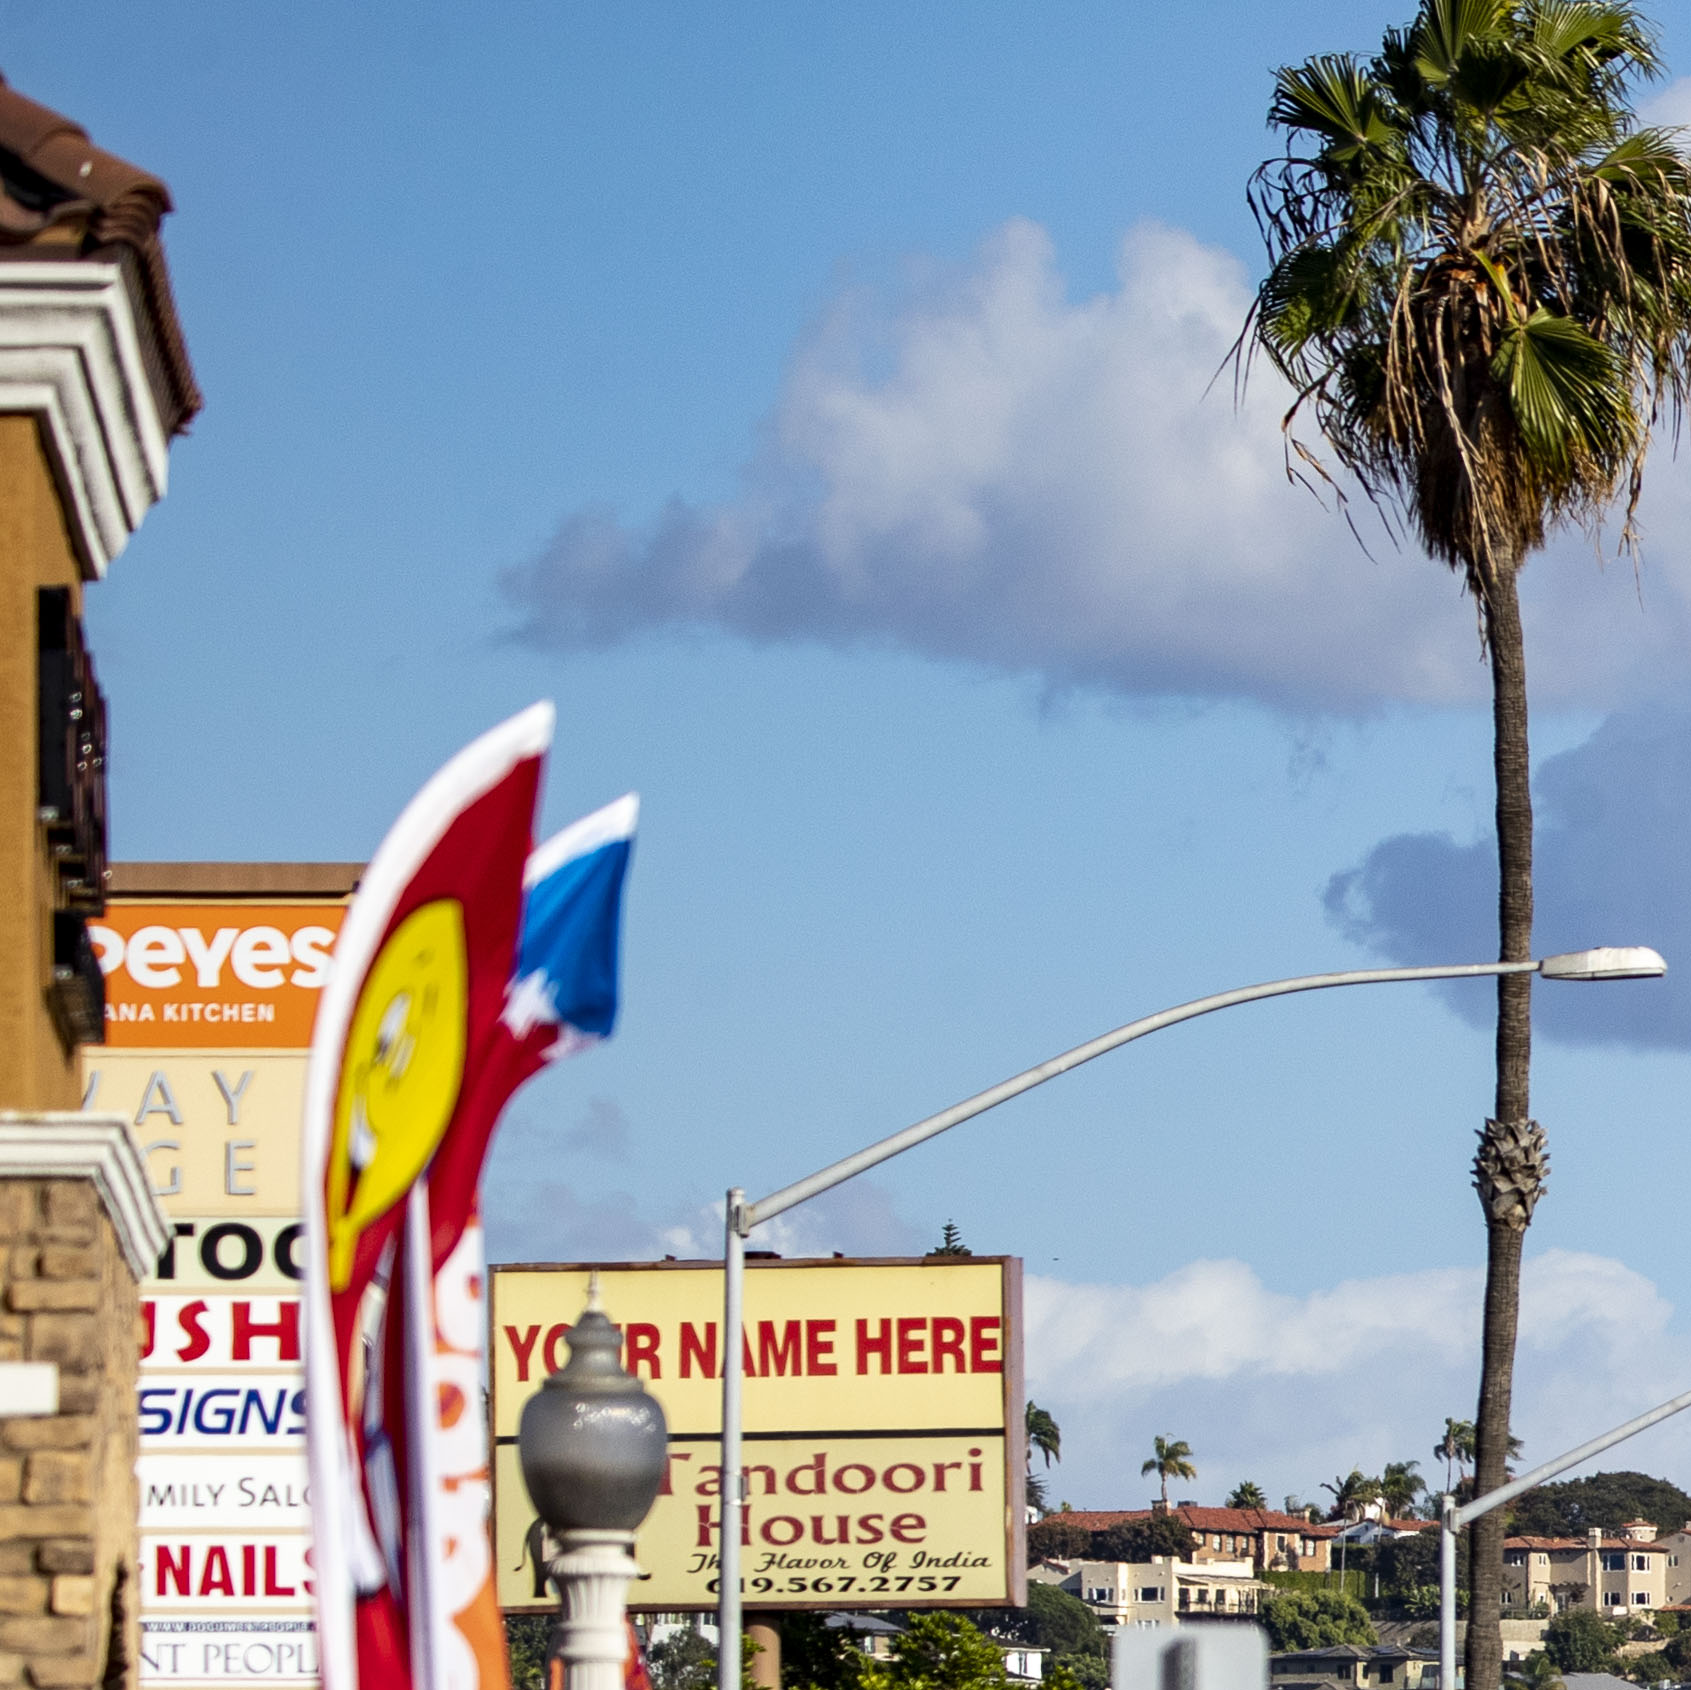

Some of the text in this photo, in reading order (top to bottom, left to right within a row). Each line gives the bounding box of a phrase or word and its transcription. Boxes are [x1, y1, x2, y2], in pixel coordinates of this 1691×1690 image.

[163, 1003, 275, 1022] KITCHEN
[84, 1070, 255, 1125] AY
[504, 1322, 662, 1382] YOR
[856, 1315, 1002, 1376] HERE
[657, 1447, 985, 1496] Tandoori
[695, 1503, 928, 1548] House
[686, 1551, 992, 1574] Th Flavor Of India
[203, 1643, 319, 1674] PEOPL
